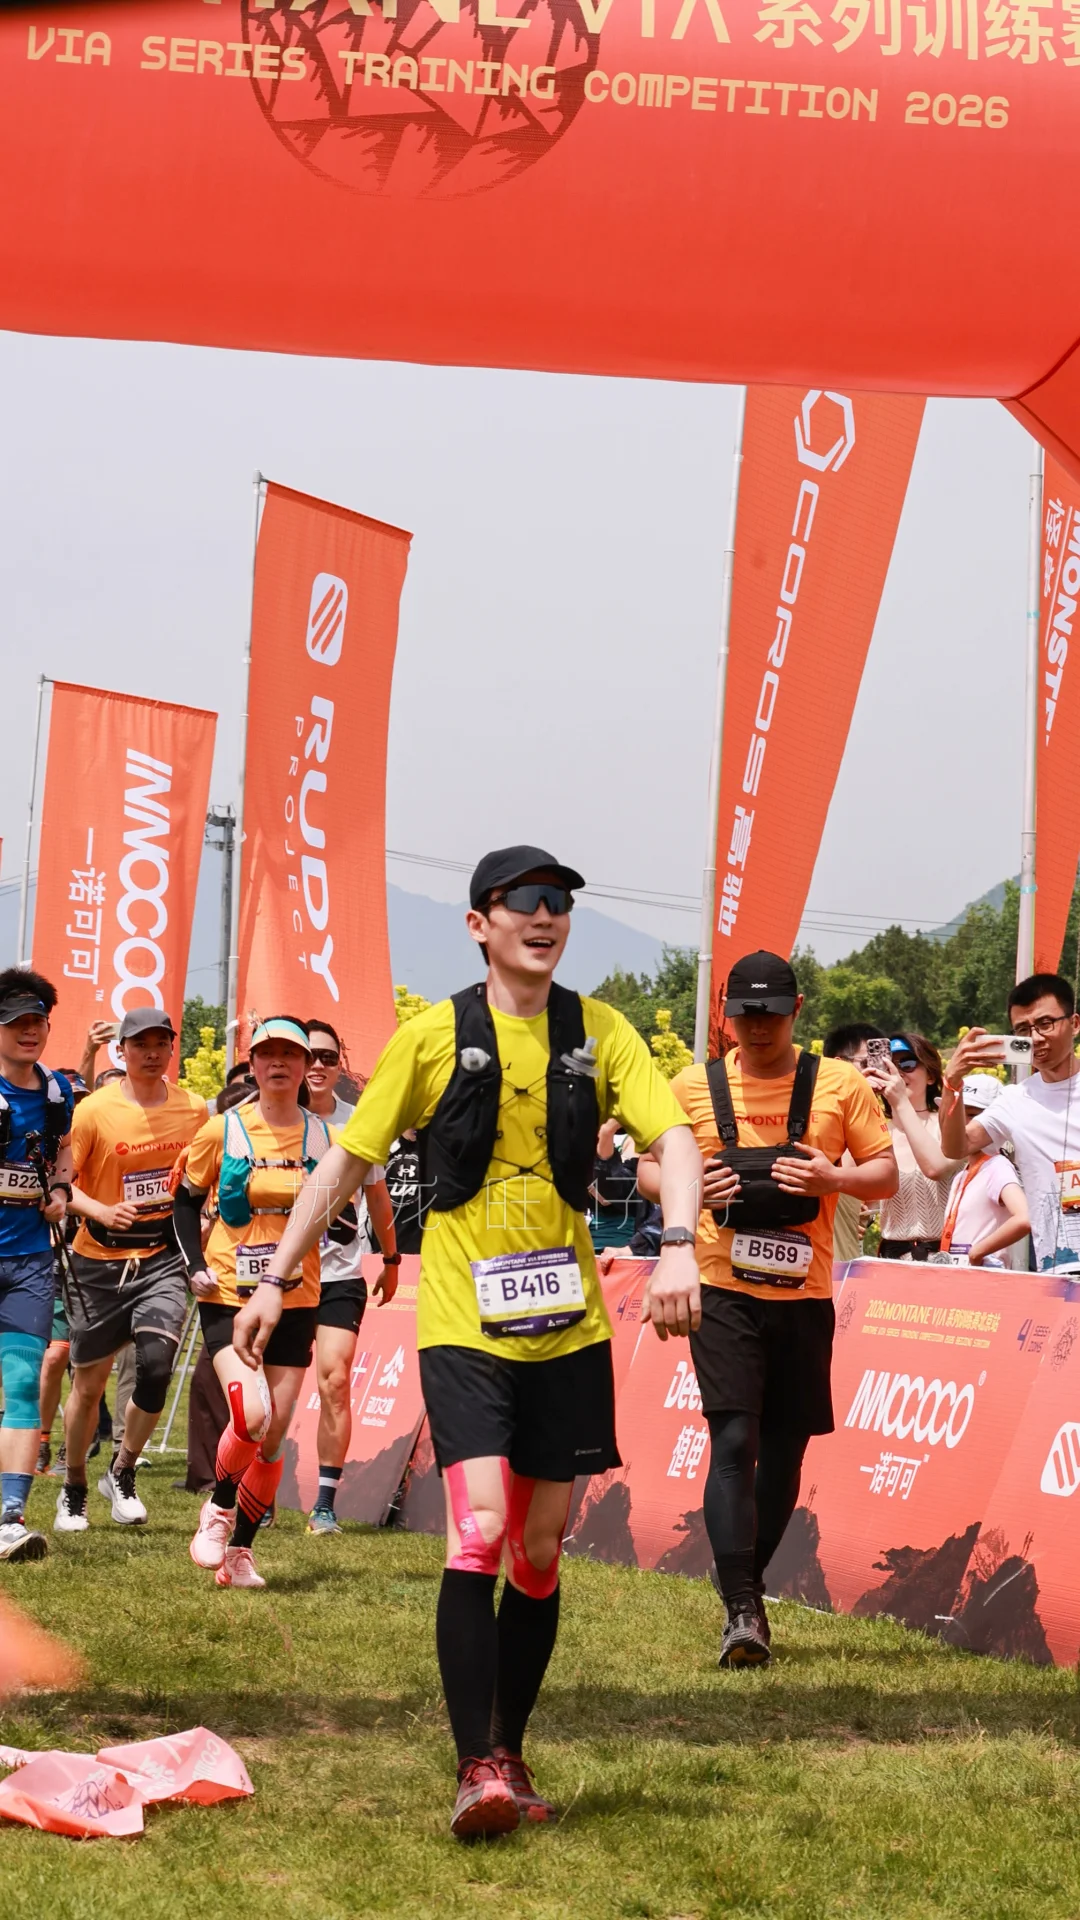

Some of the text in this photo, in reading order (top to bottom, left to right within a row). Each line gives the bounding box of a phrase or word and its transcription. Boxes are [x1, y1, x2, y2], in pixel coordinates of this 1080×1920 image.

[752, 0, 1080, 66] 系列训练
[27, 25, 1010, 129] VIA SERIES TRAINING COMPETITION 2026
[742, 479, 819, 797] COROS
[285, 715, 308, 970] PROJECT
[299, 694, 340, 1003] RUDY
[63, 827, 107, 985] 一诺可可
[735, 1112, 819, 1126] MONTE
[8, 1173, 42, 1189] B22
[748, 1239, 798, 1264] B569
[501, 1271, 560, 1302] B416
[859, 1451, 922, 1500] 一诺可可
